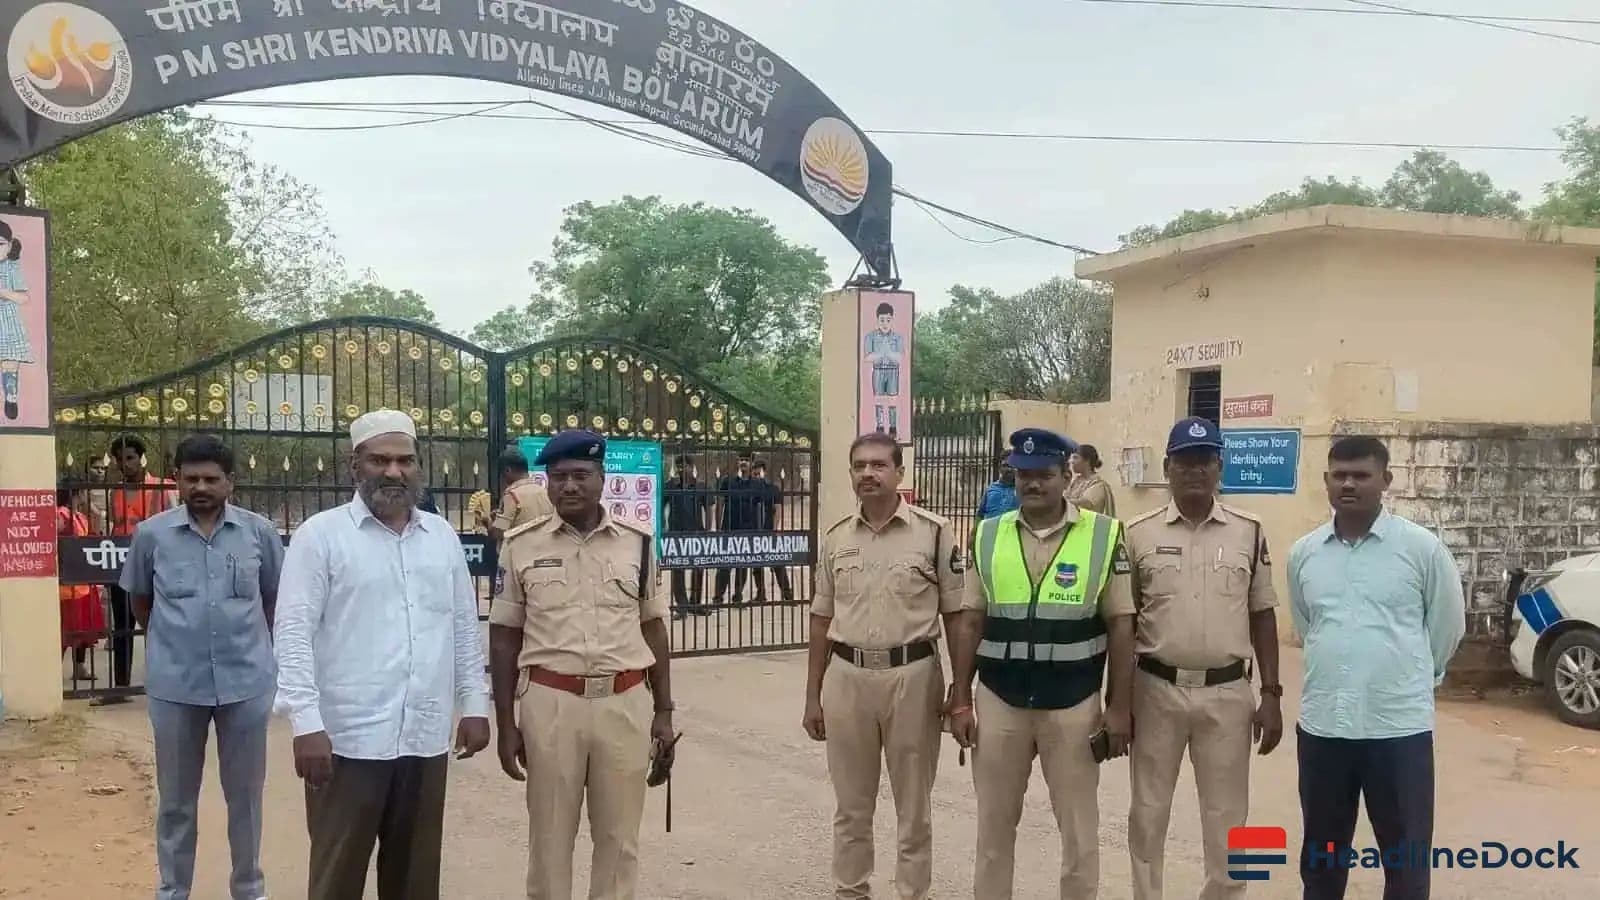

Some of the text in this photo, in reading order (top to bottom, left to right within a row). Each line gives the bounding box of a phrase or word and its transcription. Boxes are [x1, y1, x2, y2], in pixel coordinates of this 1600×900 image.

[222, 33, 297, 70] SHRI
[304, 26, 455, 60] KENDRIYA
[458, 29, 610, 87] VIDYALAYA
[623, 64, 764, 149] BOLARUM
[1198, 339, 1244, 361] SECURITY
[1224, 436, 1291, 449] Please Show Your
[1230, 452, 1285, 468] Identity before
[0, 494, 54, 508] VEHICLES
[10, 511, 37, 522] ARE
[7, 525, 41, 539] NOT
[0, 541, 53, 555] ALLOWED
[679, 536, 751, 556] VIDYALAYA
[753, 534, 809, 553] BOLARUM
[659, 556, 690, 566] LINES
[1048, 592, 1081, 602] POLICE
